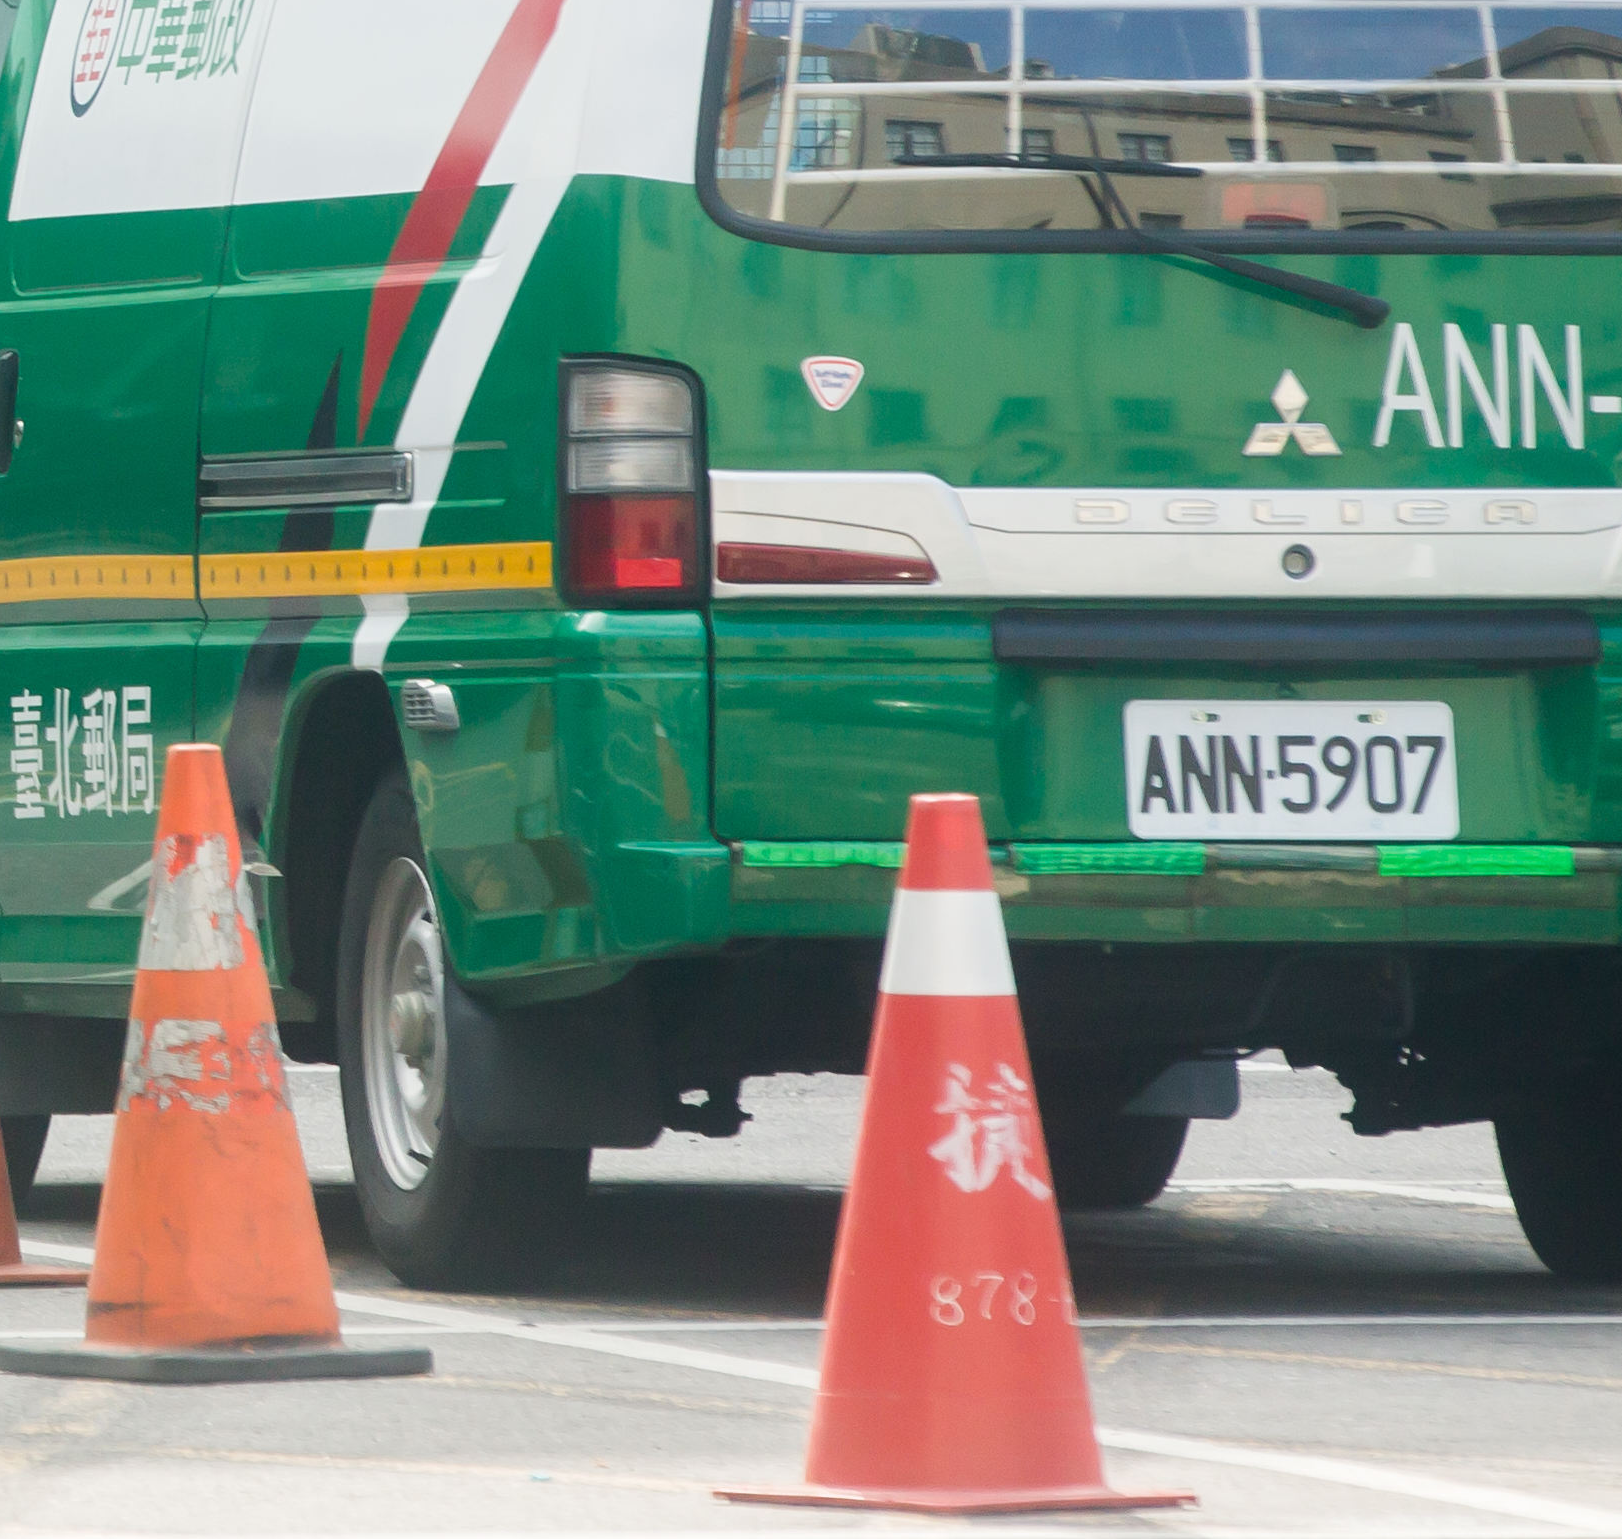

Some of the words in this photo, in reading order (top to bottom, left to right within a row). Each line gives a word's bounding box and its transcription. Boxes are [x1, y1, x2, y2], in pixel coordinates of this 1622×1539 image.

[1074, 498, 1539, 526] DELICA
[9, 686, 155, 819] 臺北郵局
